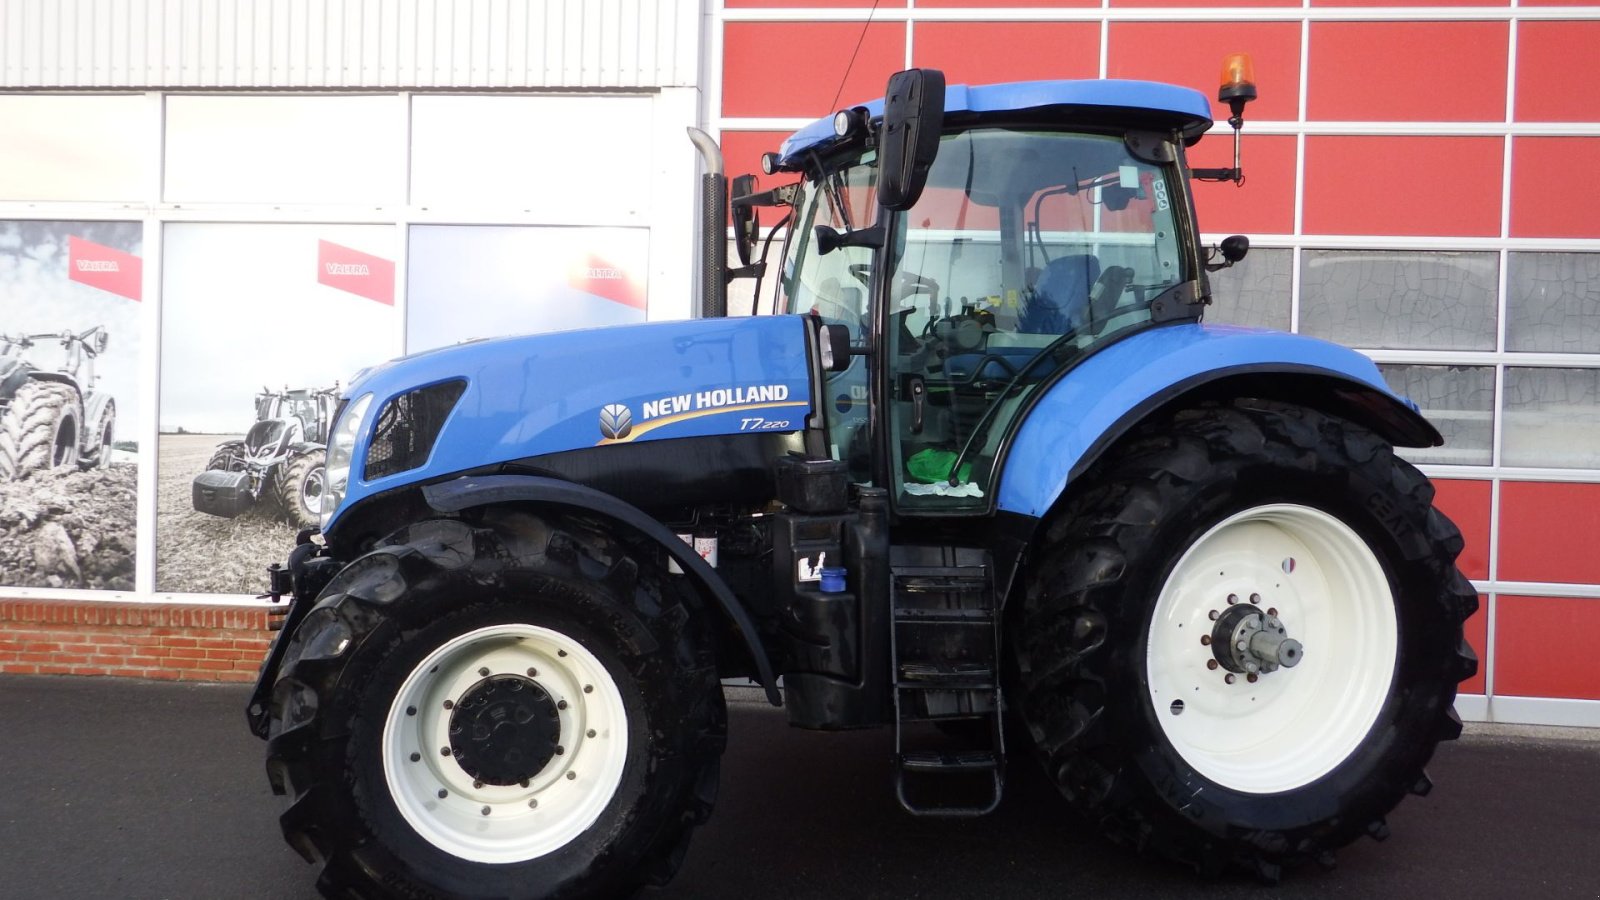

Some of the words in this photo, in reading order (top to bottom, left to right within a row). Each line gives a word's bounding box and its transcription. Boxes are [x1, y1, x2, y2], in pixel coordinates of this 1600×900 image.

[76, 259, 119, 272] VALTRA
[326, 262, 370, 275] VALTRA
[643, 395, 691, 419] NEW
[696, 384, 788, 409] HOLLAND
